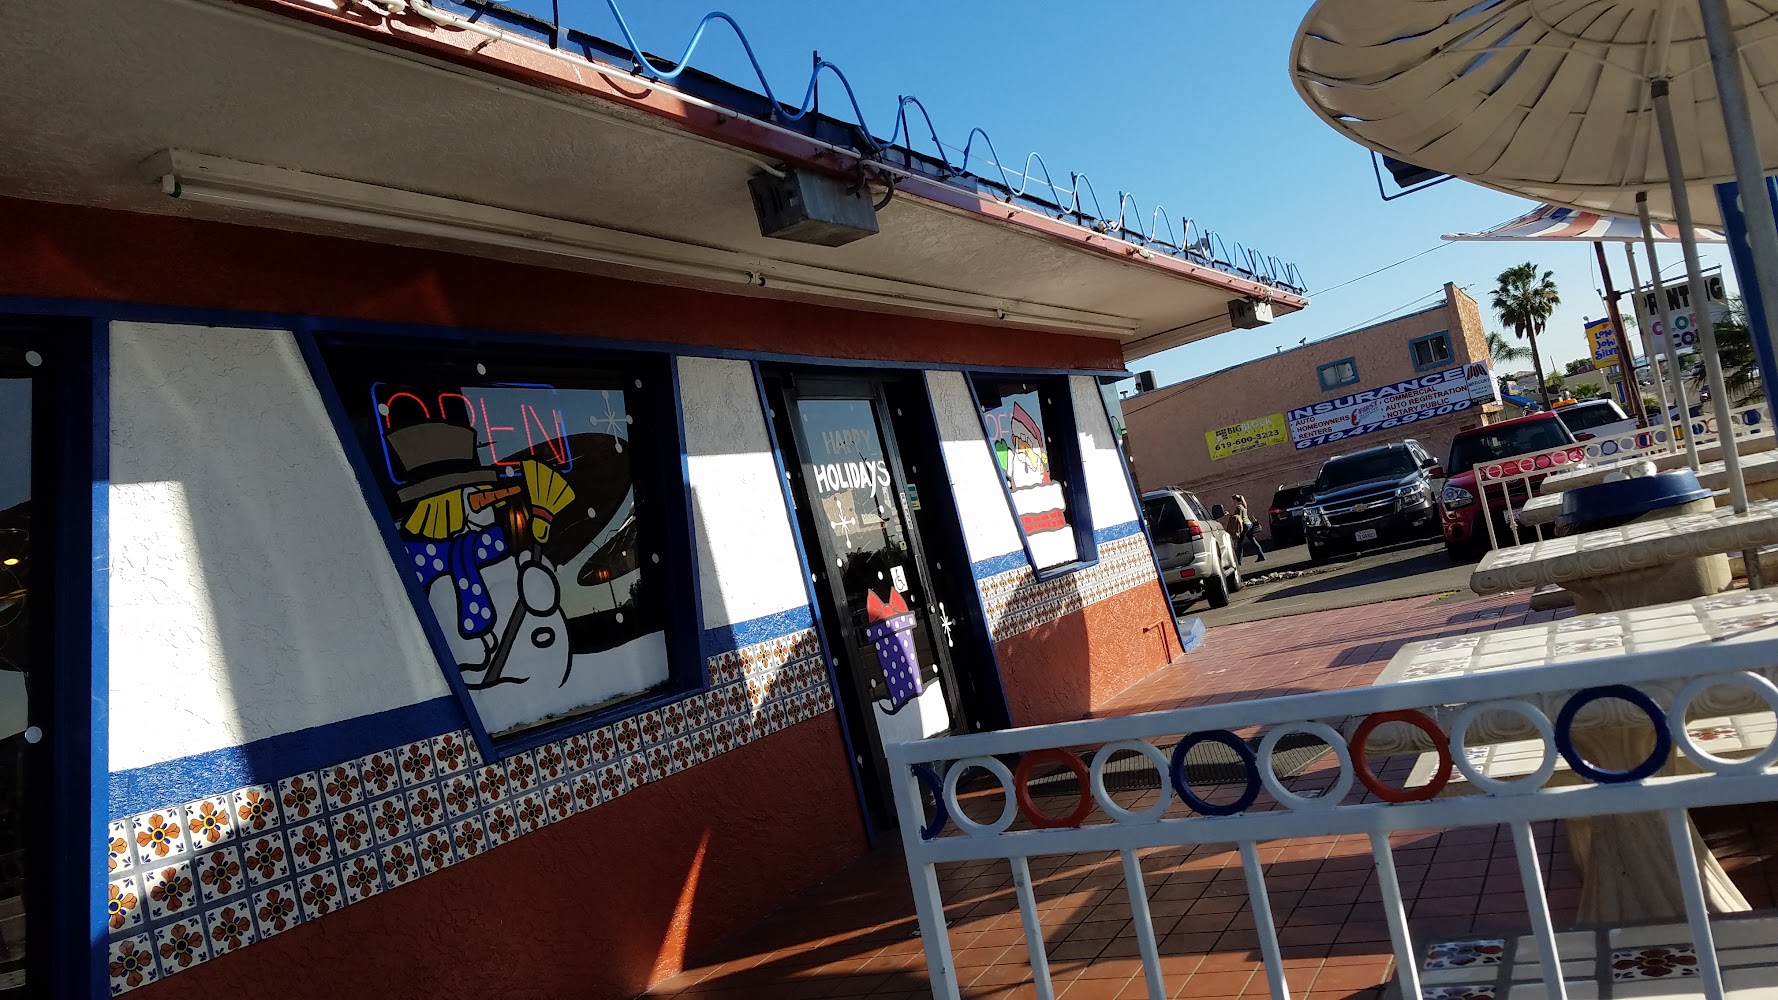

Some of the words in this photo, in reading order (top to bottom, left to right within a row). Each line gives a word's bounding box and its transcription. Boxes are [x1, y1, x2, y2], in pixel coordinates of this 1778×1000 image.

[1288, 367, 1464, 421] INSURANCE
[1384, 386, 1437, 404] COMMERCIAL
[1385, 400, 1407, 411] AUTO
[1409, 385, 1468, 405] REGISTRATION
[1387, 405, 1419, 418] NOTARY
[1420, 397, 1450, 410] PUBLIC
[1295, 416, 1316, 427] AUTO
[1296, 400, 1471, 449] 619.476.9300
[1297, 414, 1351, 433] HOMEOWNERS
[1298, 426, 1333, 439] RENTERS
[822, 428, 871, 455] HAPPY
[1215, 429, 1279, 451] 619-600-3223
[812, 460, 891, 499] HOLIDAYS
